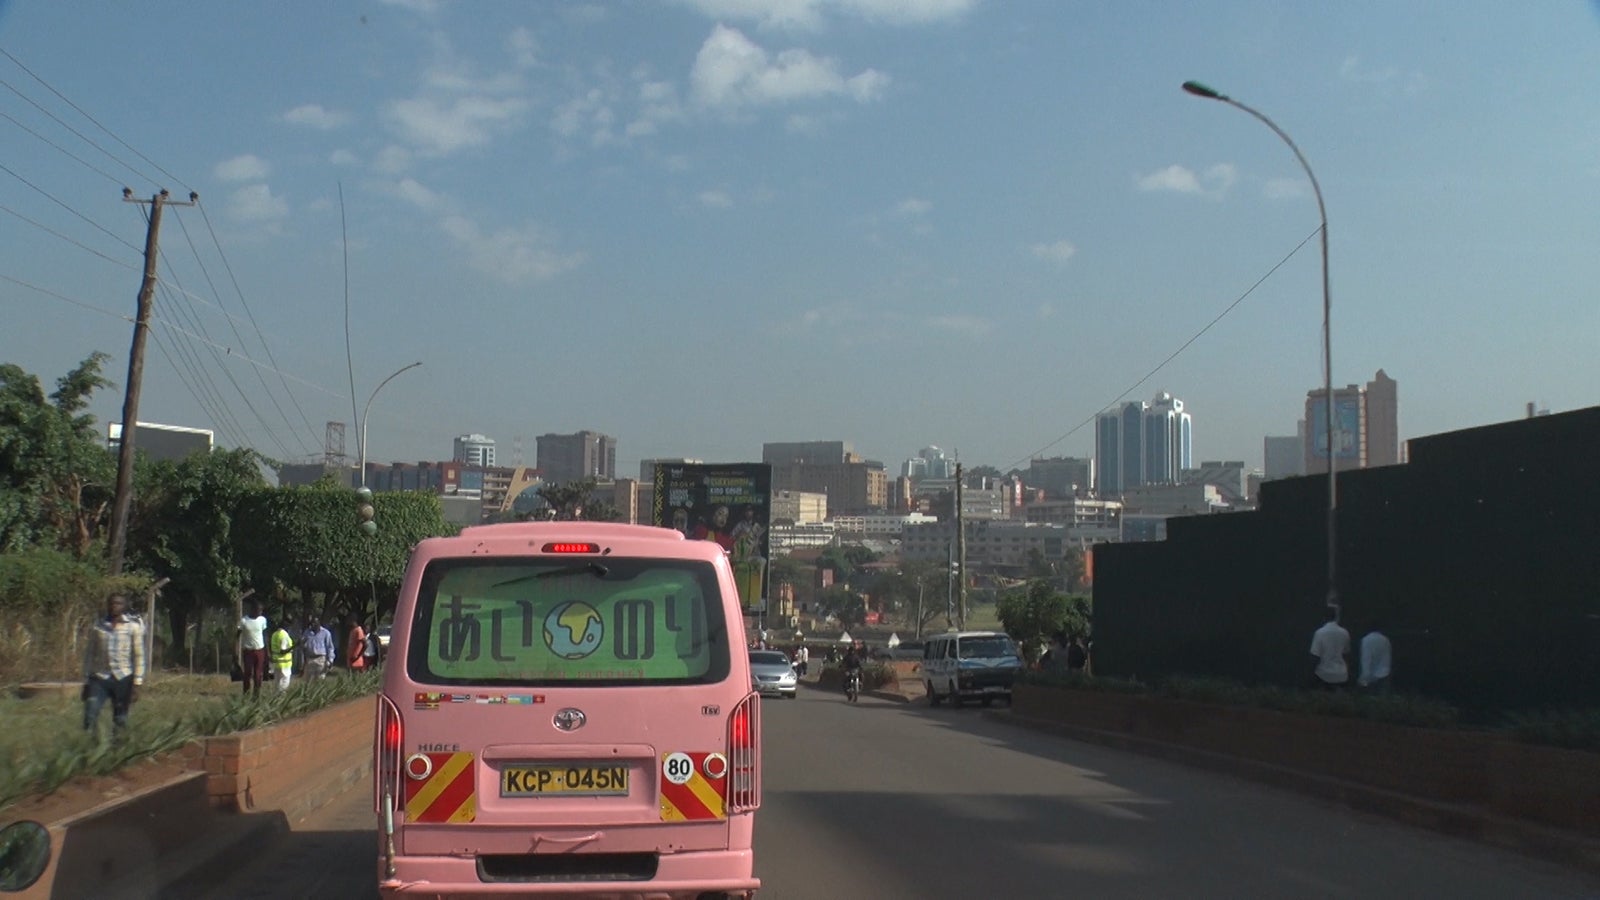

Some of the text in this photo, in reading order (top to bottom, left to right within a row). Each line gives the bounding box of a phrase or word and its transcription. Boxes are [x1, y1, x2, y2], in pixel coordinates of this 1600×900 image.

[418, 743, 460, 752] HIACE
[668, 759, 690, 775] 80
[507, 767, 624, 792] KCP 045N
